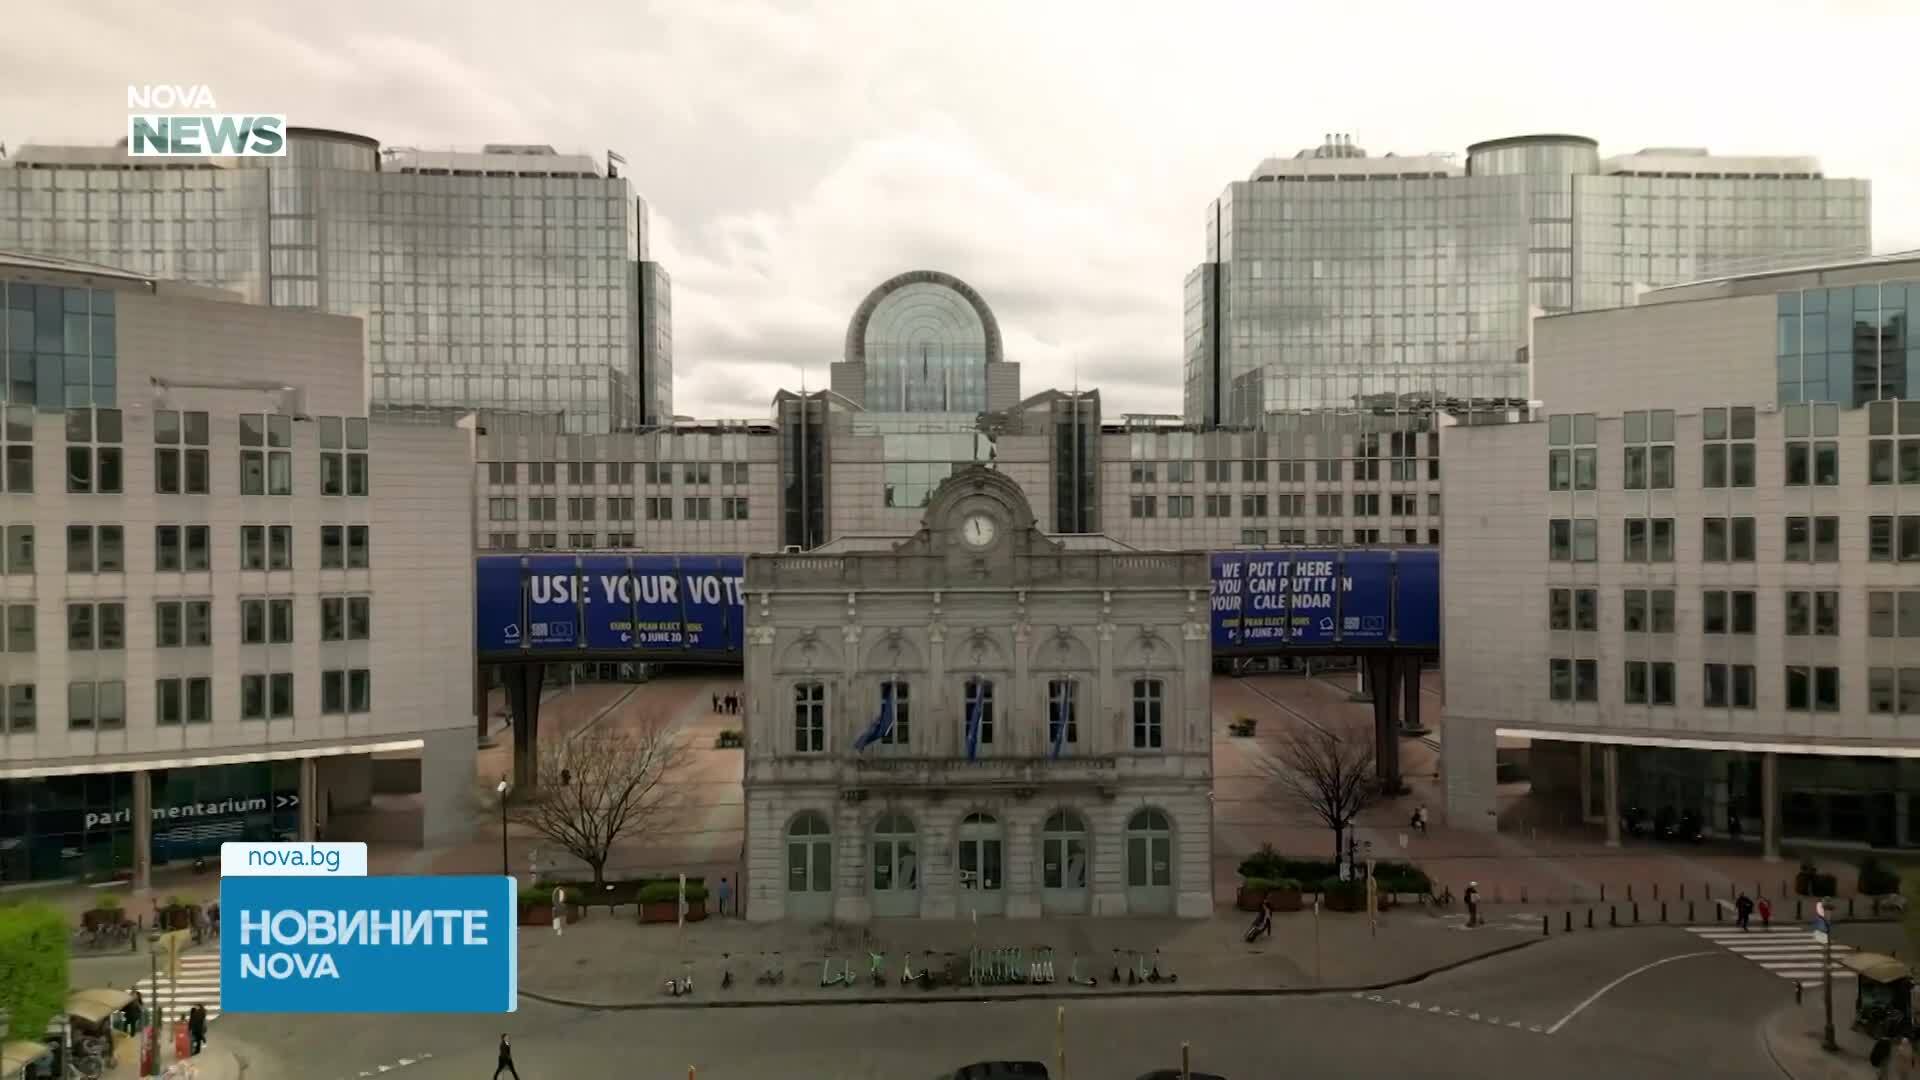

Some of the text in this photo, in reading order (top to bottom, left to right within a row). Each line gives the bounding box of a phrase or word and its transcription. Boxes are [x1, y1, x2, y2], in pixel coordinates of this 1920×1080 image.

[1222, 561, 1333, 578] WE PUT IT HERE
[530, 575, 592, 604] USE
[600, 575, 679, 604] YOUR
[1219, 578, 1241, 594] YOU
[1249, 578, 1276, 593] CAN
[1279, 578, 1310, 593] PUT
[1314, 577, 1328, 592] IT
[1331, 577, 1352, 592] IN
[1211, 594, 1331, 611] YOUR CALENDAR
[648, 632, 669, 642] JUNE
[671, 632, 699, 643] 2024
[1251, 628, 1272, 638] JUNE
[86, 797, 267, 830] parlmentarium
